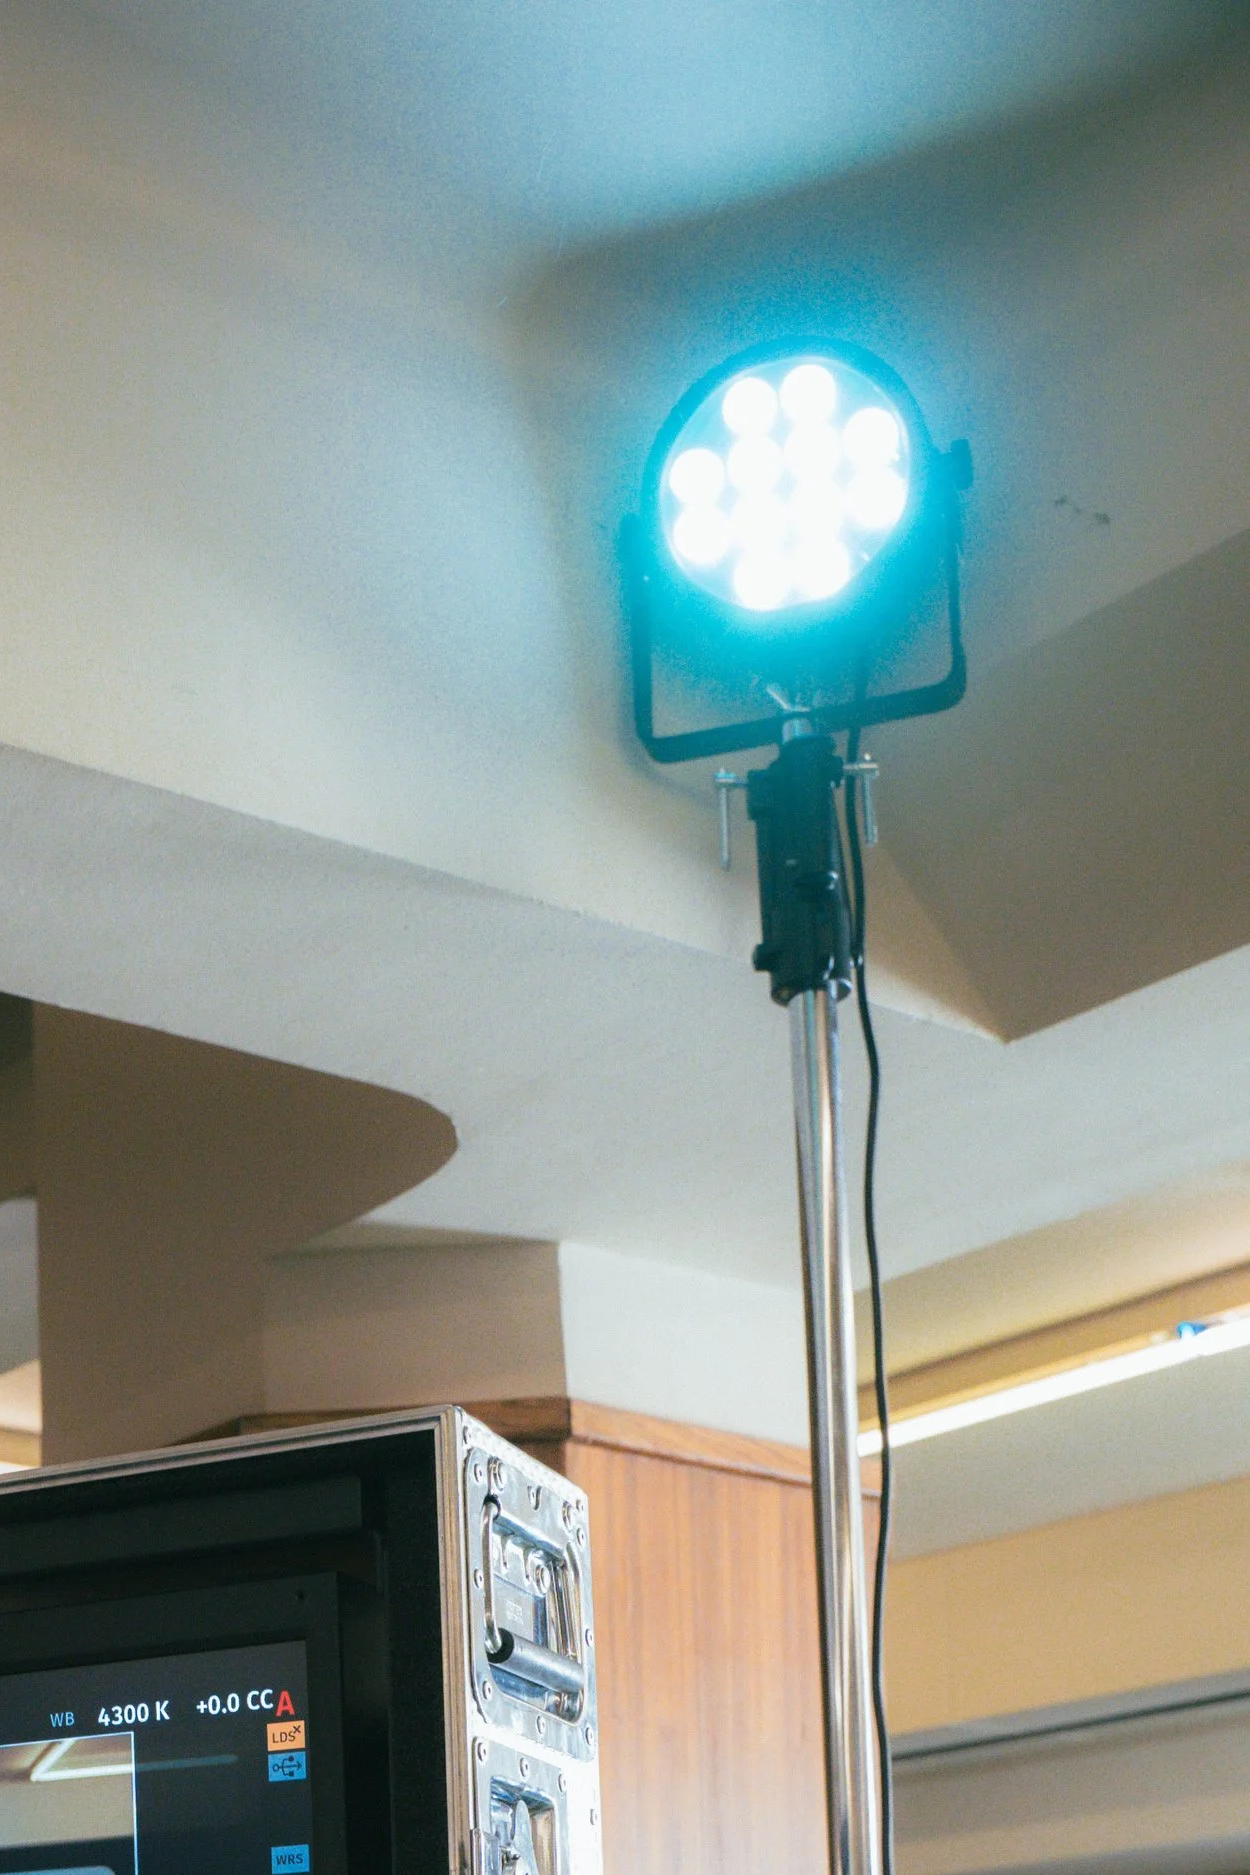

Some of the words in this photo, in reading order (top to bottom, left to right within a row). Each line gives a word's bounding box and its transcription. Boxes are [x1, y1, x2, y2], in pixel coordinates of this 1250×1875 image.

[50, 1711, 76, 1728] WB
[97, 1702, 151, 1727] 4300
[155, 1700, 170, 1722] K
[196, 1692, 240, 1716] +0.0
[246, 1688, 274, 1711] CC
[275, 1690, 296, 1717] A
[275, 1851, 304, 1868] WRS
